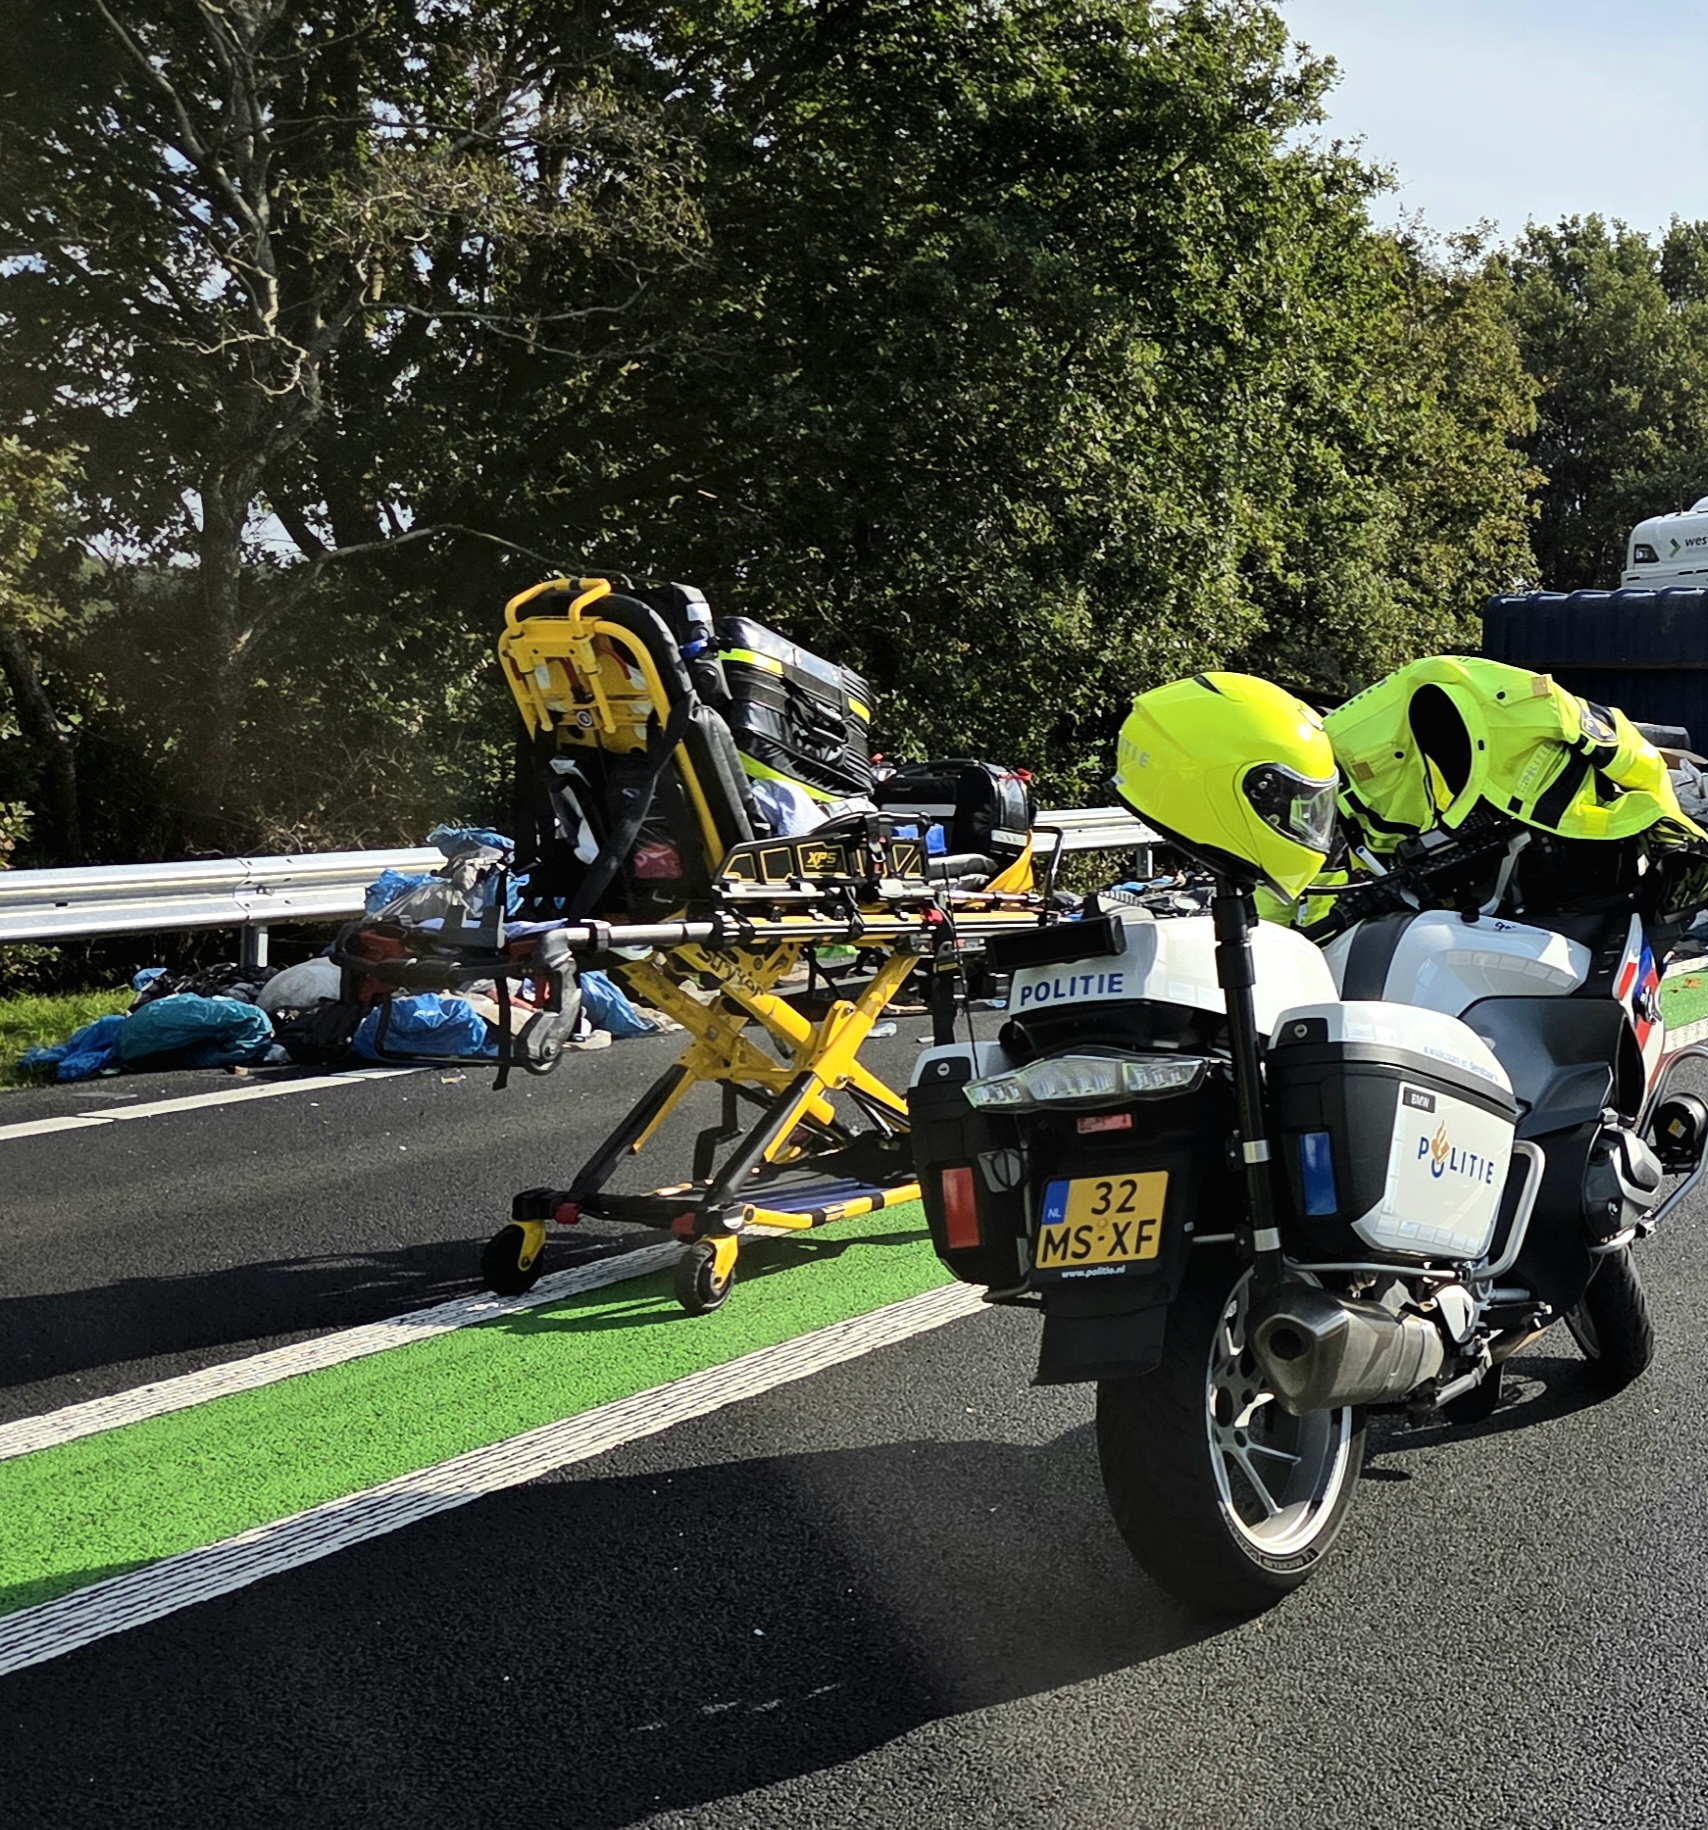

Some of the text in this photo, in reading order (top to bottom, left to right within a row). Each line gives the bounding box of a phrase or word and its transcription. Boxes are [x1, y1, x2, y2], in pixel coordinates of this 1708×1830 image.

[807, 851, 837, 864] XPS
[1020, 973, 1124, 1006] POLITIE
[1417, 1136, 1495, 1185] POLITIE
[1047, 1207, 1062, 1219] NL
[1090, 1179, 1138, 1216] 32
[1041, 1218, 1157, 1263] MS-XF
